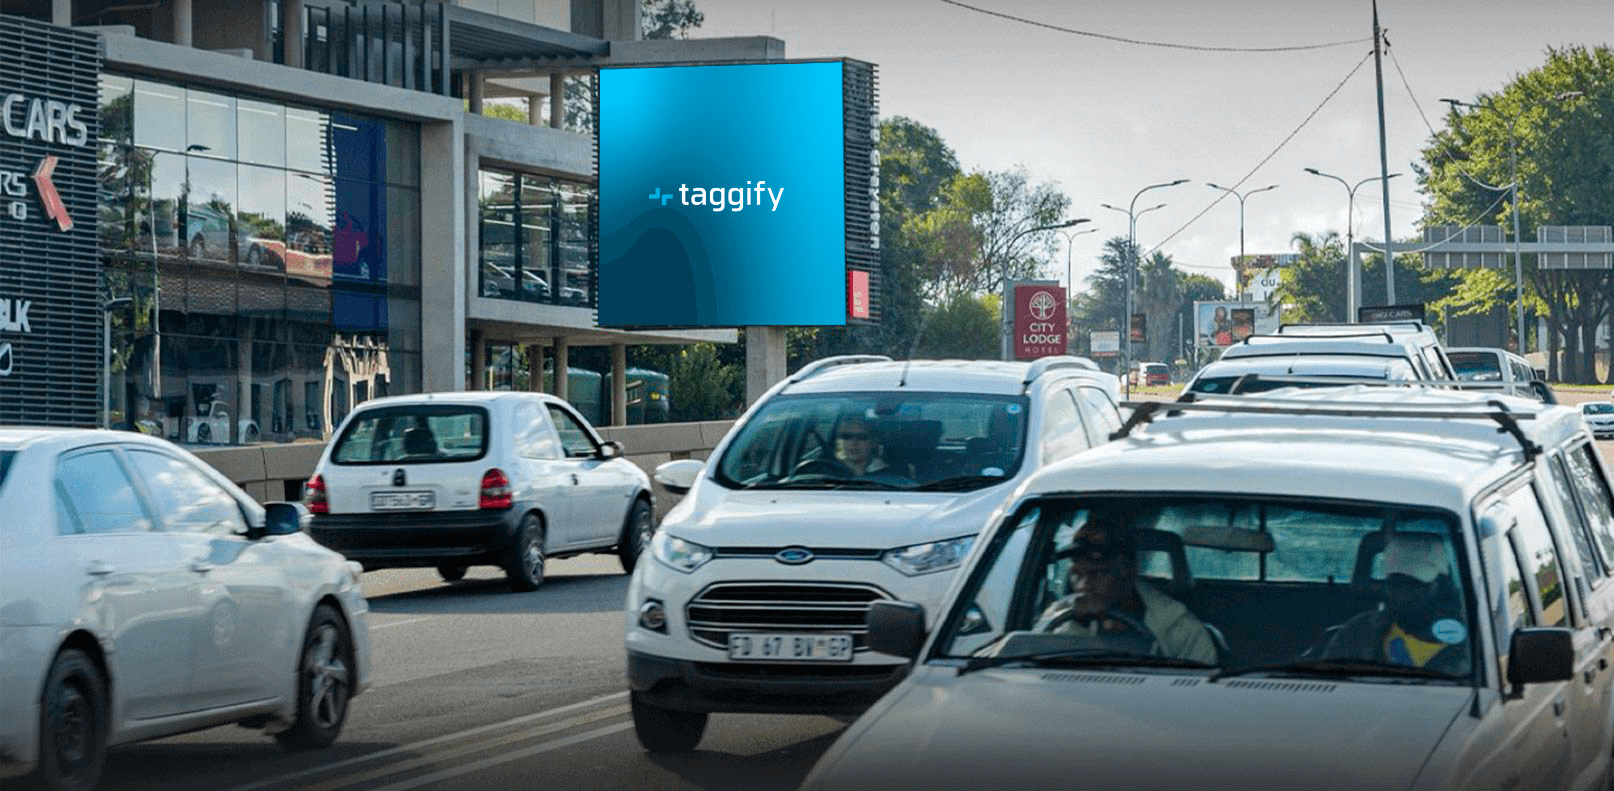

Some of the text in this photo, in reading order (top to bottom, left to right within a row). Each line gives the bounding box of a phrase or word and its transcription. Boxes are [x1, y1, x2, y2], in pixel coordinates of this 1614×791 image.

[3, 94, 88, 147] CARS
[678, 180, 785, 212] taggify
[869, 149, 881, 249] Grayston
[1029, 322, 1055, 332] CITY
[1023, 334, 1061, 344] LODGE
[1025, 346, 1059, 354] HOTEL
[762, 636, 782, 656] 67
